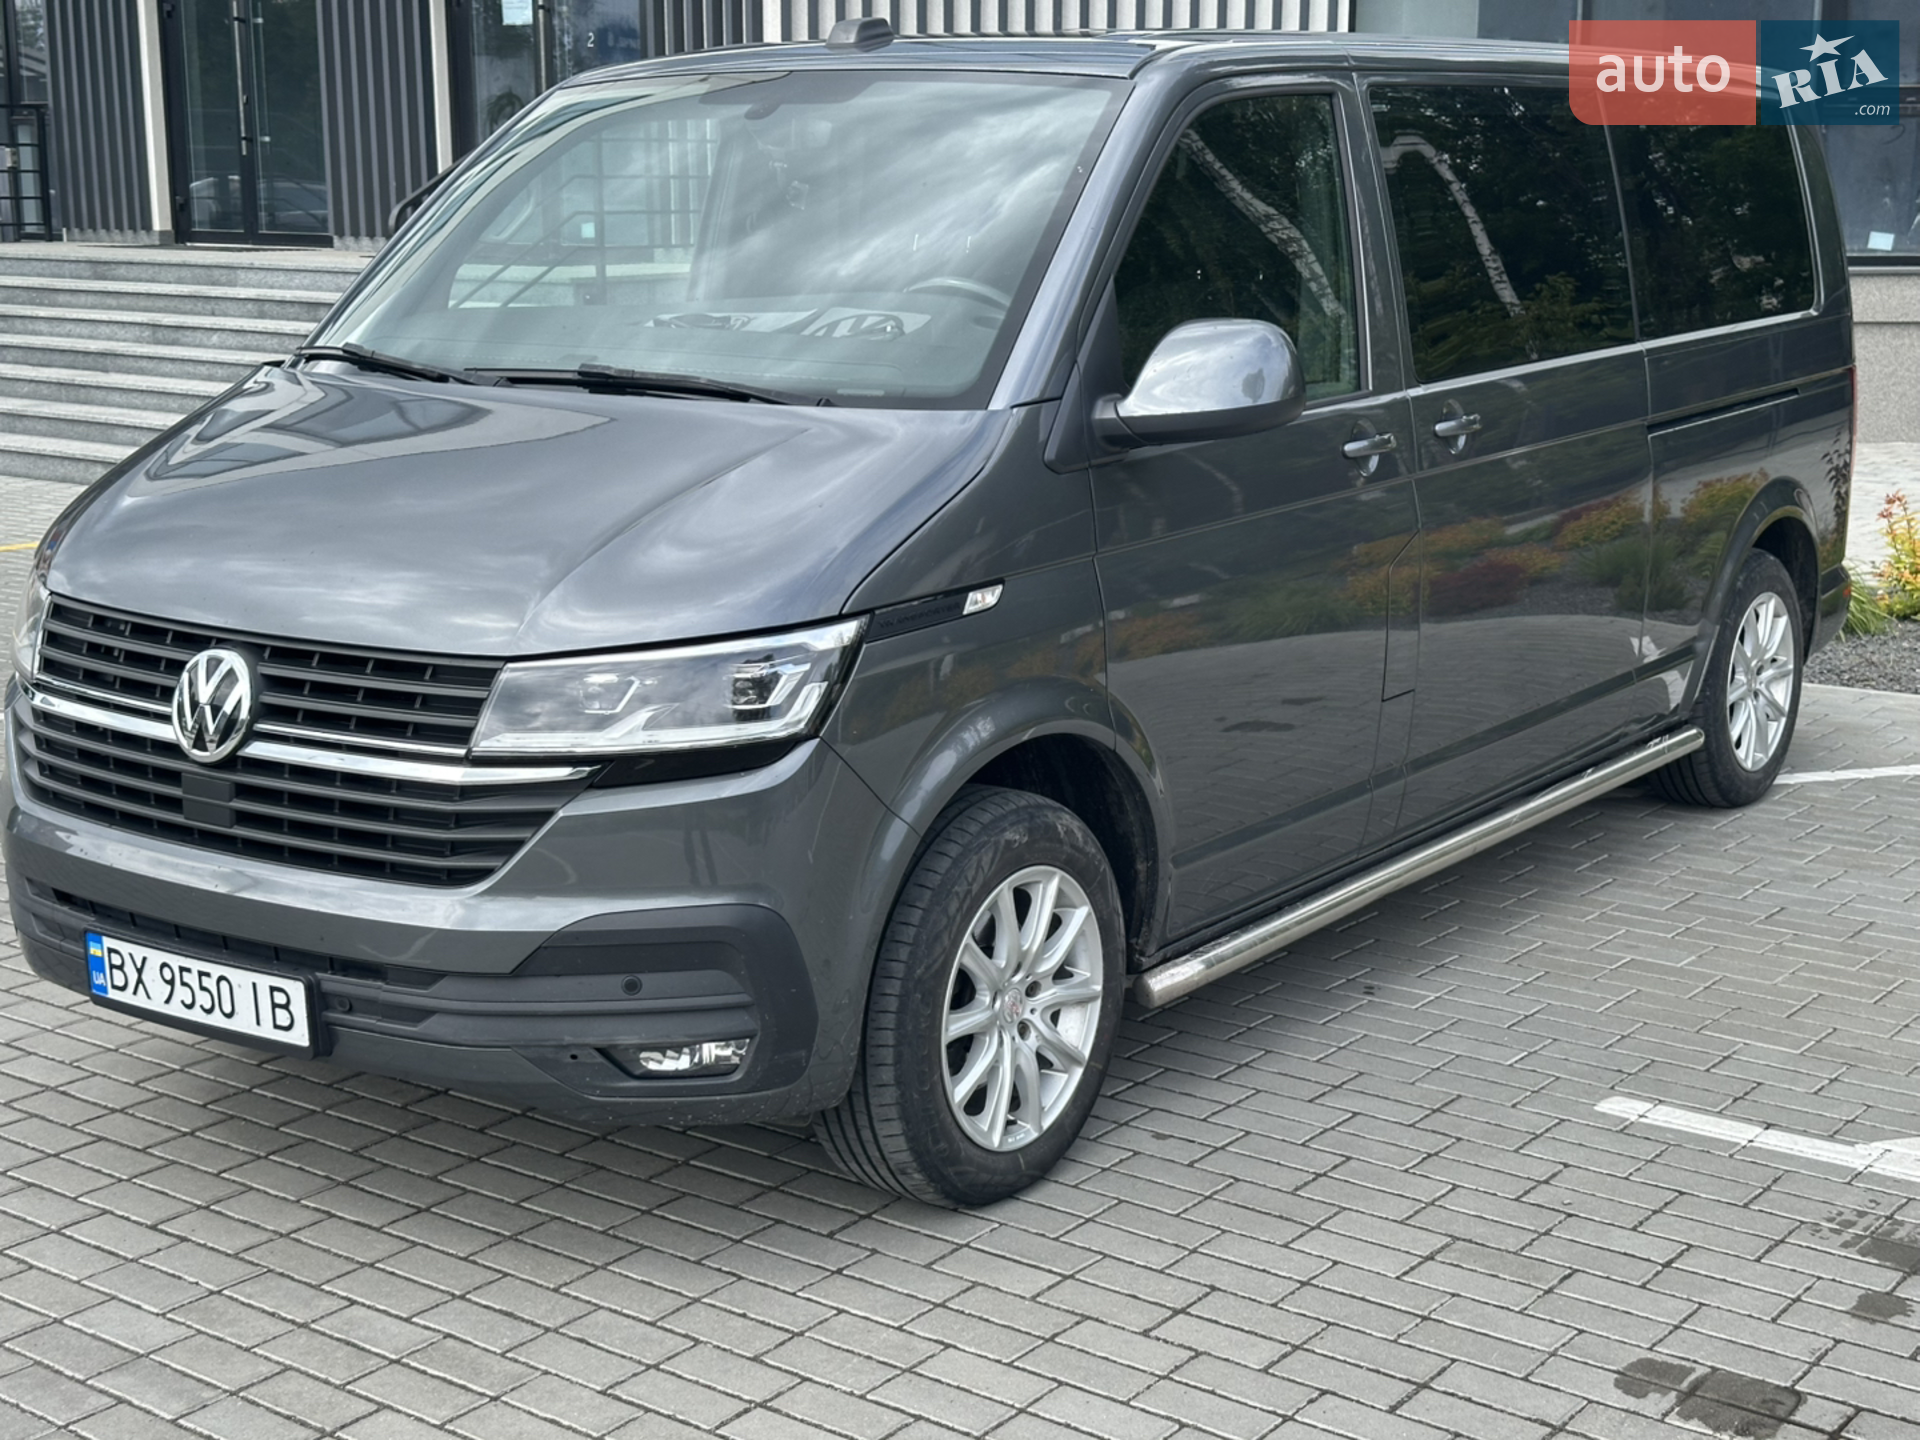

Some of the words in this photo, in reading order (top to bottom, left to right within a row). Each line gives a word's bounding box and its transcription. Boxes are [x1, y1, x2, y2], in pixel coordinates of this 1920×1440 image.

[587, 32, 595, 48] 2
[175, 650, 250, 762] VW
[92, 970, 106, 987] UA
[106, 946, 152, 1000] BX
[159, 961, 236, 1019] 9550
[251, 981, 295, 1032] IB
